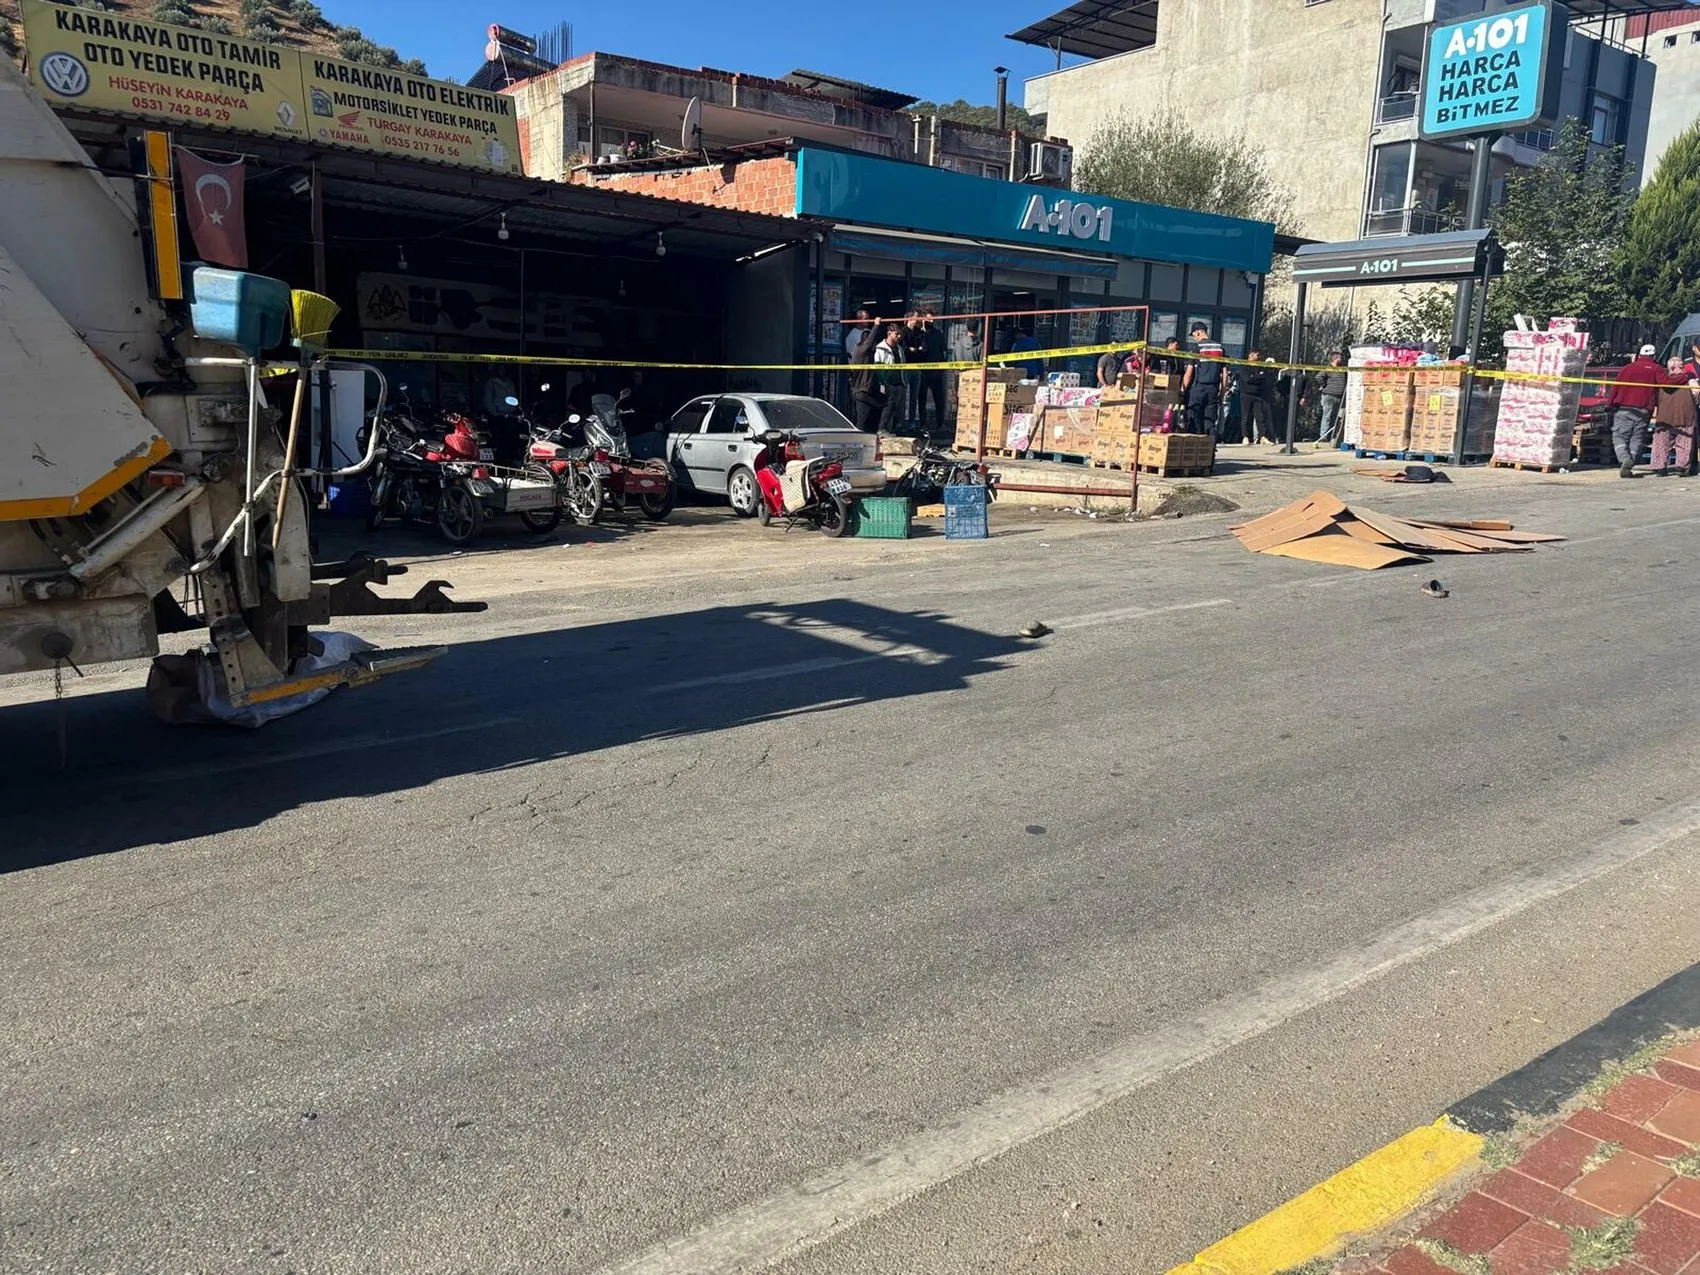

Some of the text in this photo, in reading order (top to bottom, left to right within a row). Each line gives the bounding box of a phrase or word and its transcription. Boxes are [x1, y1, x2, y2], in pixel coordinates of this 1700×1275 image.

[55, 9, 281, 70] KARAKAYA OTO TAMİR
[84, 42, 264, 94] OTO YEDEK PARÇA
[1441, 50, 1521, 81] HARCA
[175, 87, 249, 111] KARAKAYA
[314, 61, 509, 116] KARAKAYA OTO ELEKTRİK
[1439, 72, 1518, 102] HARCA
[132, 97, 230, 122] 0531 742 84 29
[334, 92, 498, 136] MOTORSİKLET YEDEK PARÇA
[329, 128, 370, 145] YAMAHA
[367, 116, 412, 134] TURGAY
[414, 127, 473, 146] KARAKAYA
[384, 136, 460, 157] 0535 217 76 56
